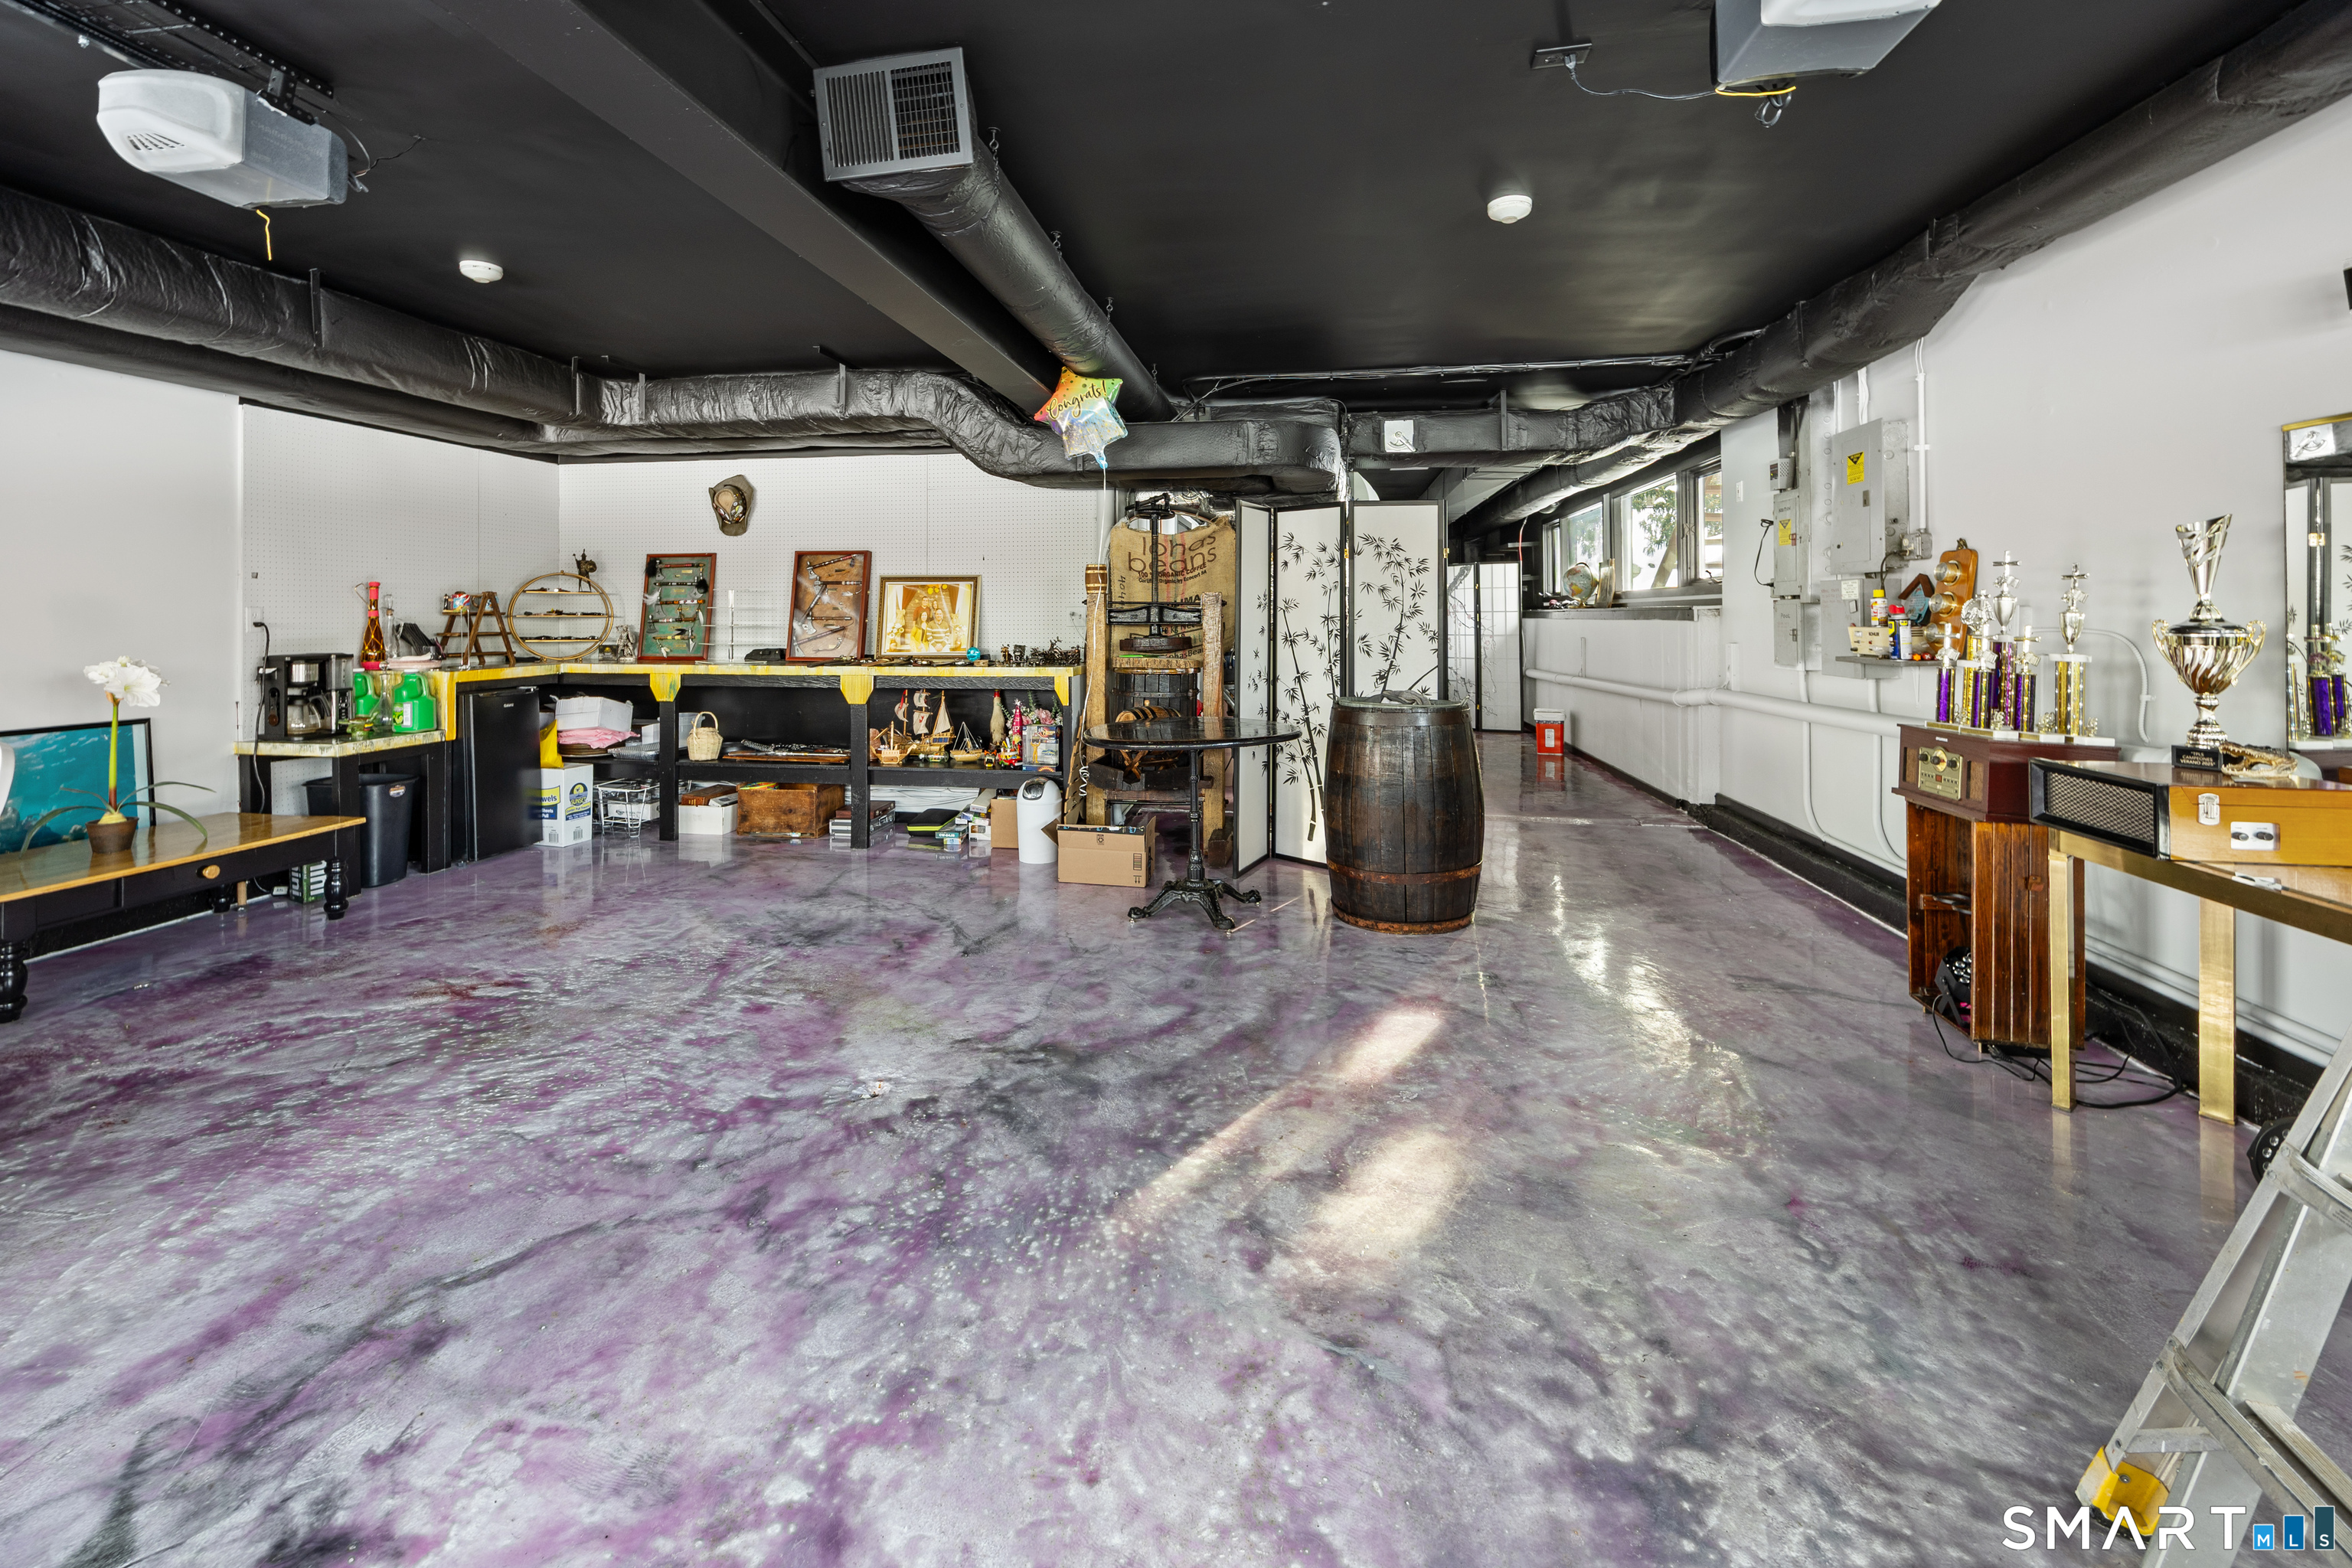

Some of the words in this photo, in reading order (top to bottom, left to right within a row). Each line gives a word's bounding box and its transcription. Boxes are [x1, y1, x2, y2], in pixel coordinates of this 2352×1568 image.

[1046, 380, 1107, 420] Congrats!
[1142, 535, 1217, 557] lohas
[1129, 547, 1217, 573] beans
[1186, 562, 1207, 575] COFFEE
[1184, 573, 1200, 582] Ecocert
